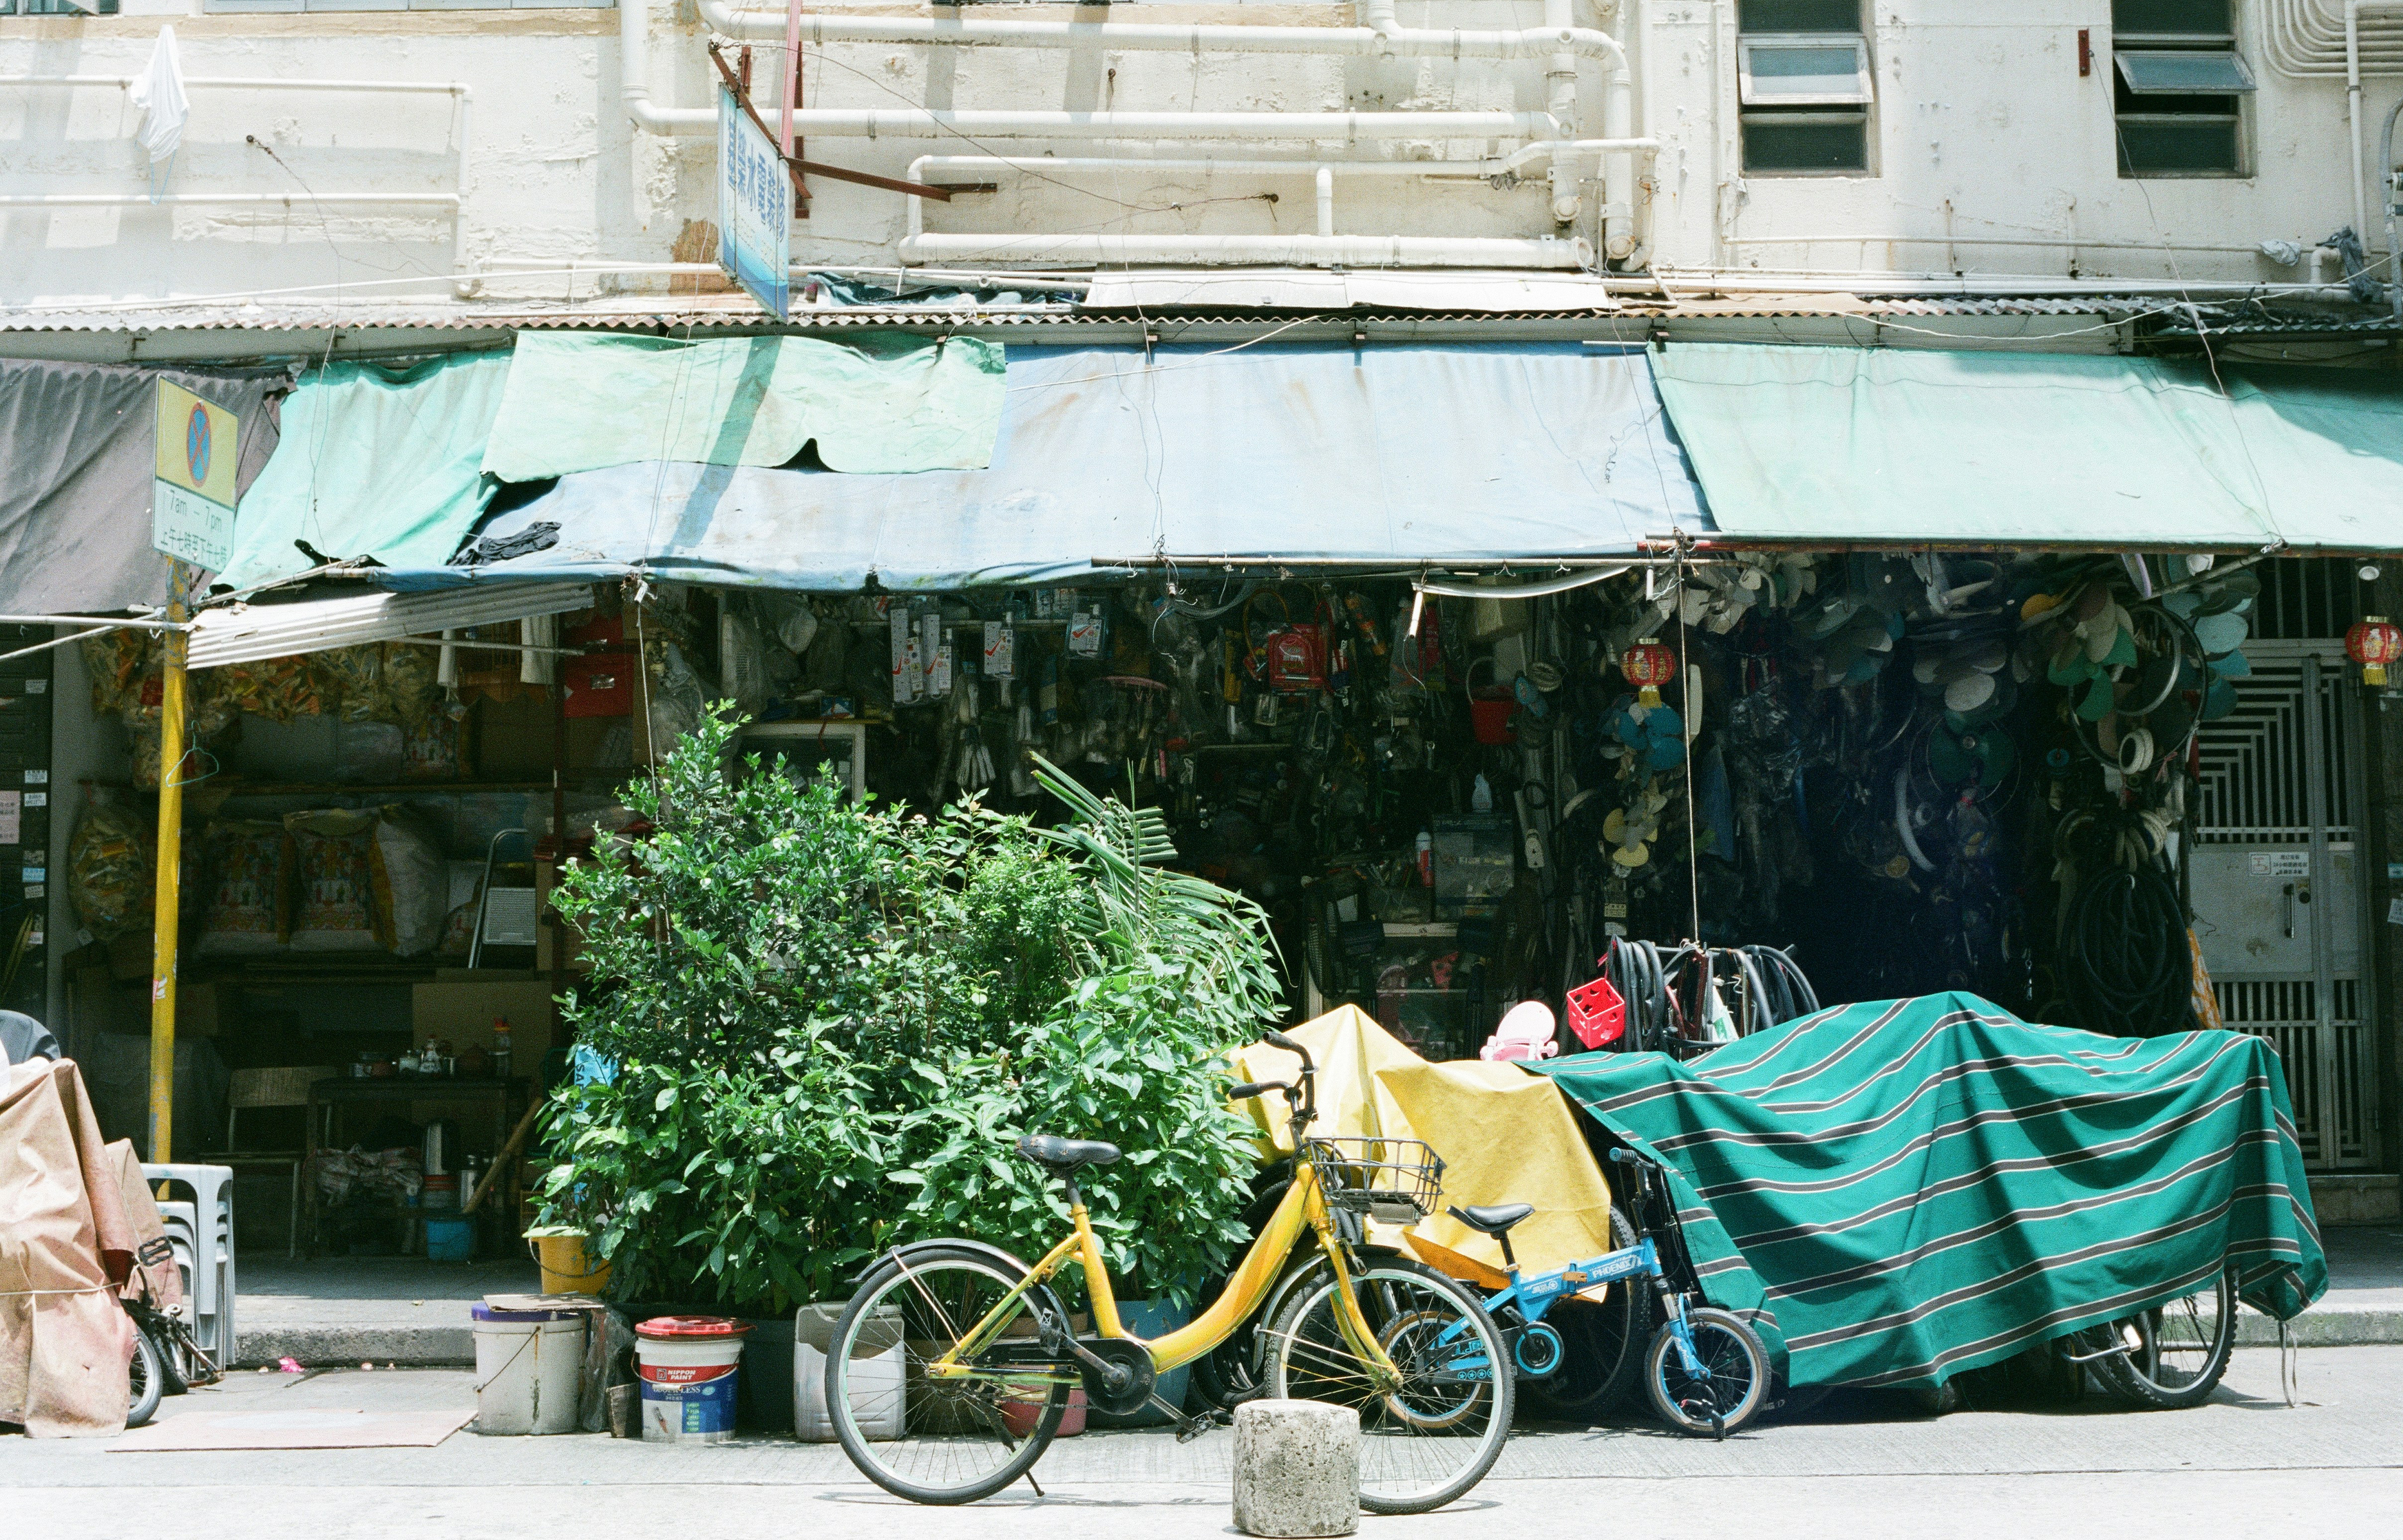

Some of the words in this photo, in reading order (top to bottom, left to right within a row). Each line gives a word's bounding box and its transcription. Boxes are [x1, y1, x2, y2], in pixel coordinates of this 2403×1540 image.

[169, 489, 187, 516] 7am
[205, 505, 222, 533] 7pm
[160, 526, 227, 567] 上午七時至下午七時
[1592, 1260, 1631, 1278] PHOENIX
